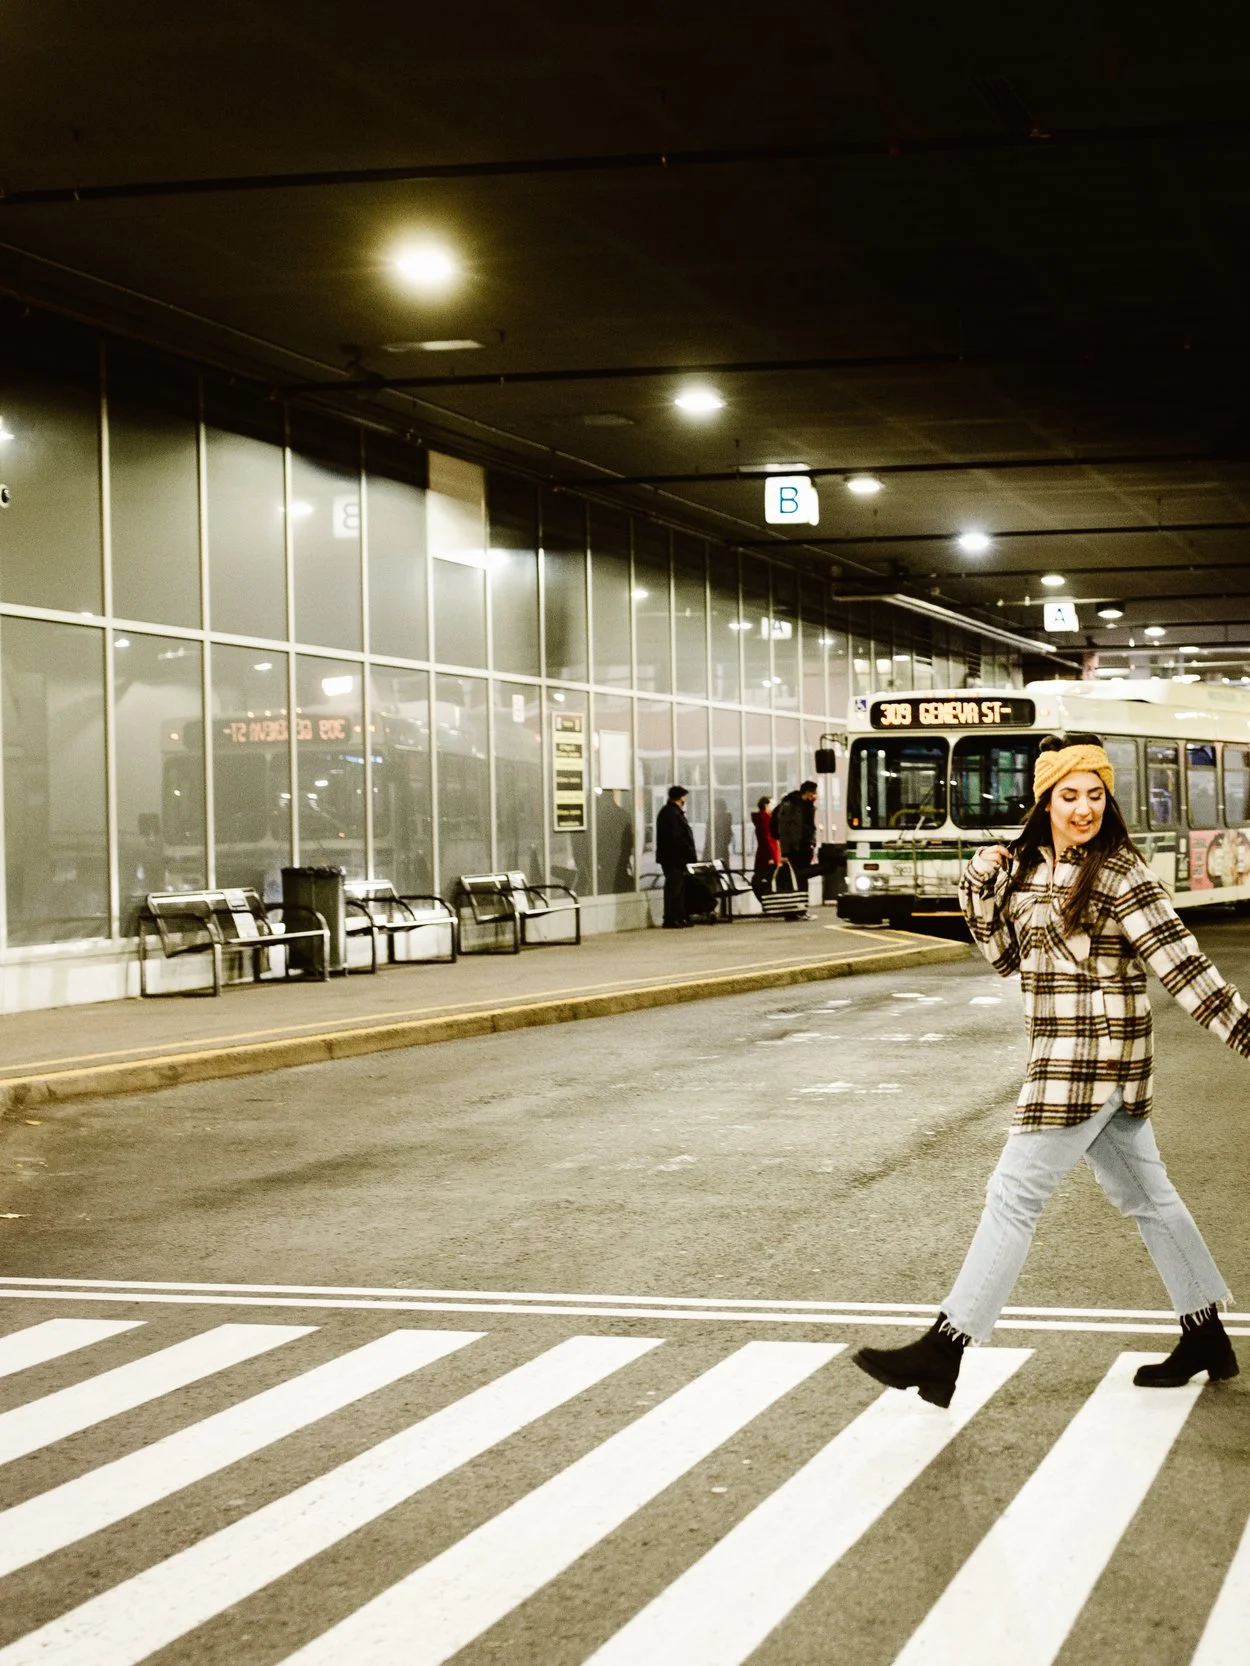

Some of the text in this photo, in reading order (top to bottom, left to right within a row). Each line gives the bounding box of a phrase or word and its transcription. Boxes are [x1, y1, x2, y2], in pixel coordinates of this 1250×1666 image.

[780, 486, 799, 514] B
[1053, 607, 1066, 625] A
[880, 703, 912, 726] 309
[919, 701, 980, 725] GENEVA
